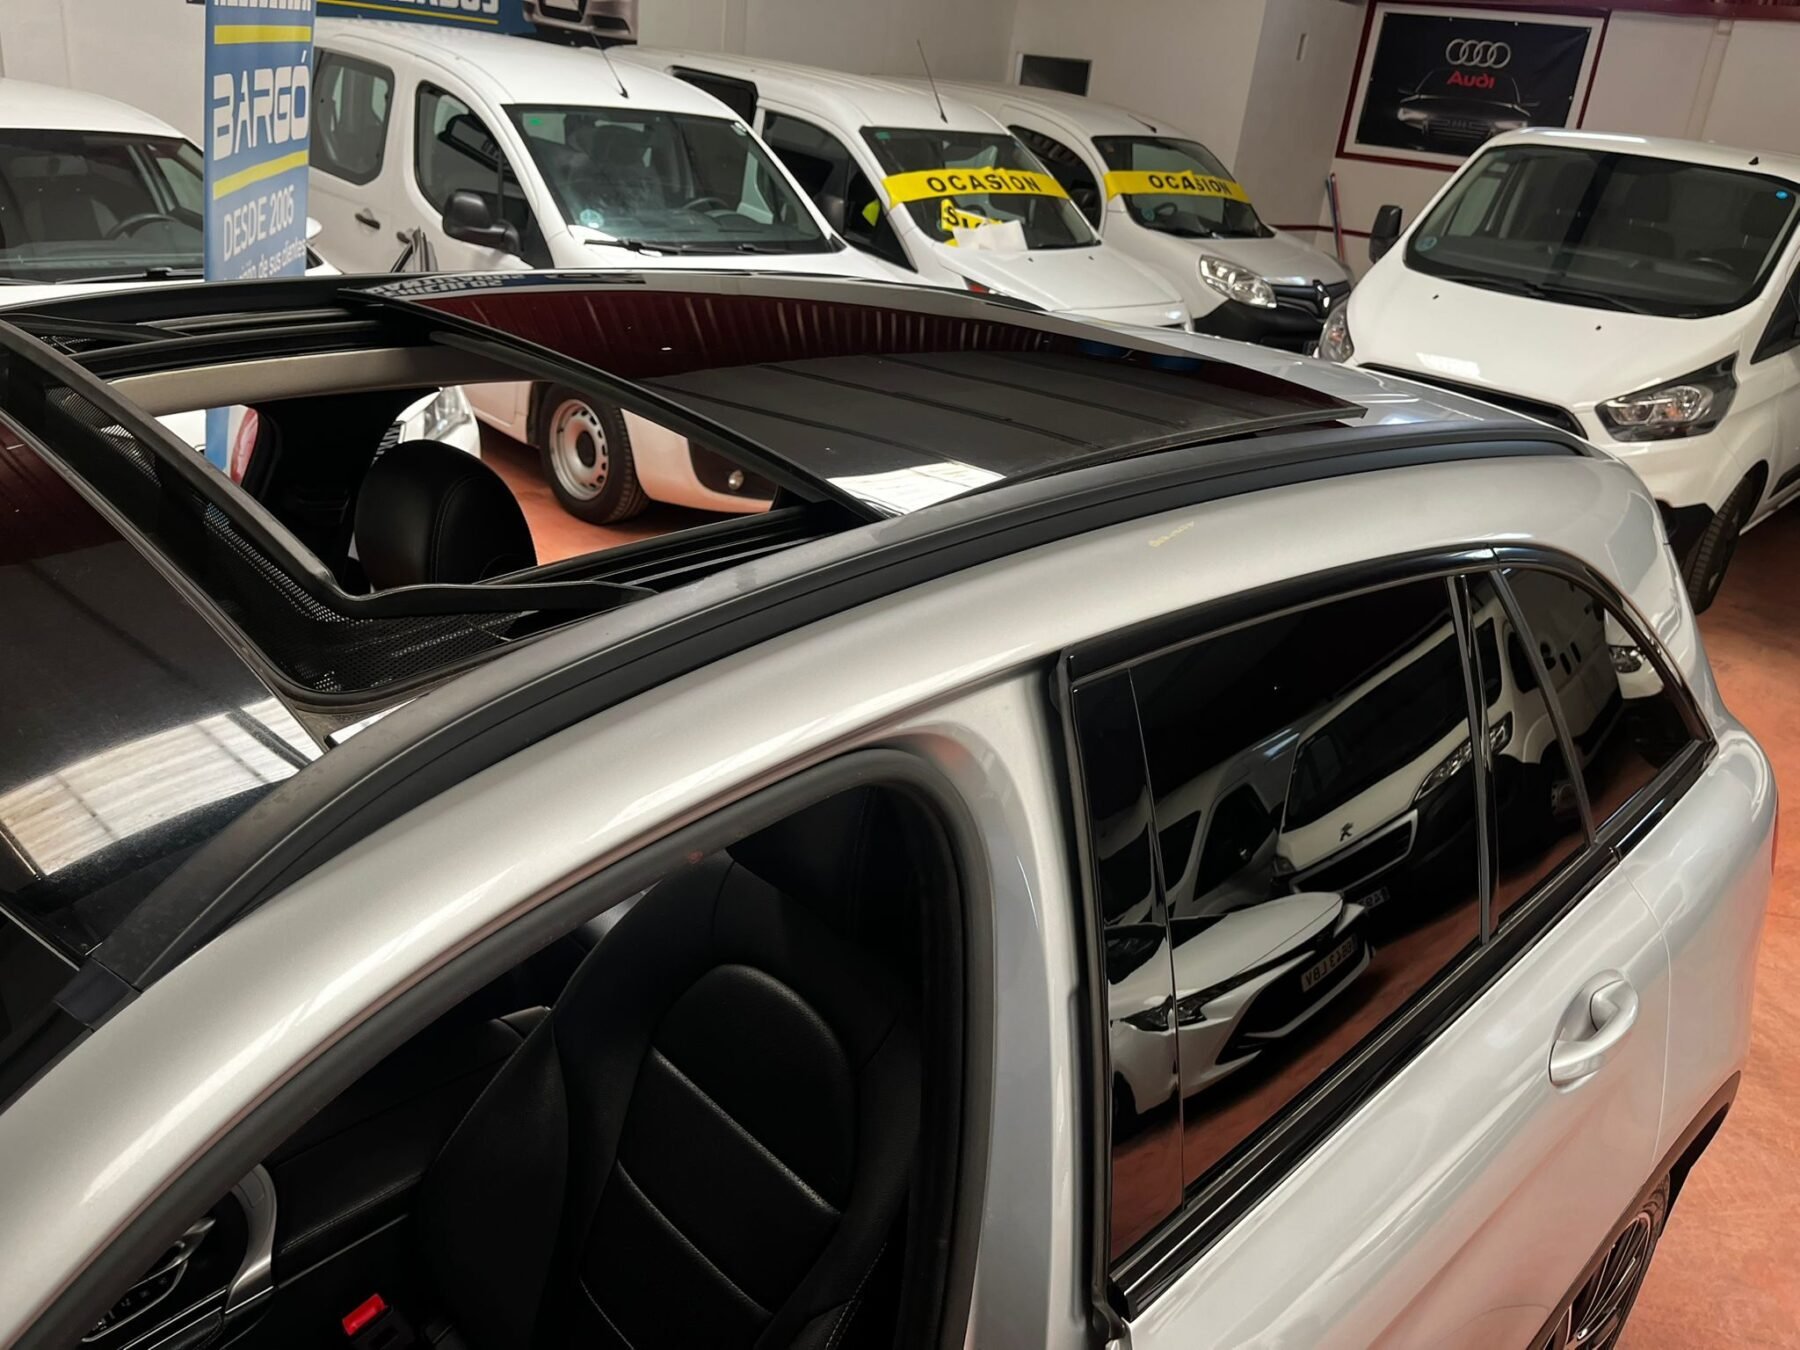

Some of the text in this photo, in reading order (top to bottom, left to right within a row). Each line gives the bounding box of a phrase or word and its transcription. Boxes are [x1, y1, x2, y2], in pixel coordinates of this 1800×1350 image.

[1446, 69, 1497, 89] Audi
[213, 50, 310, 161] BARGÓ
[926, 173, 1042, 193] OCASION
[1148, 174, 1233, 196] OCASION
[223, 196, 268, 262] DESDE
